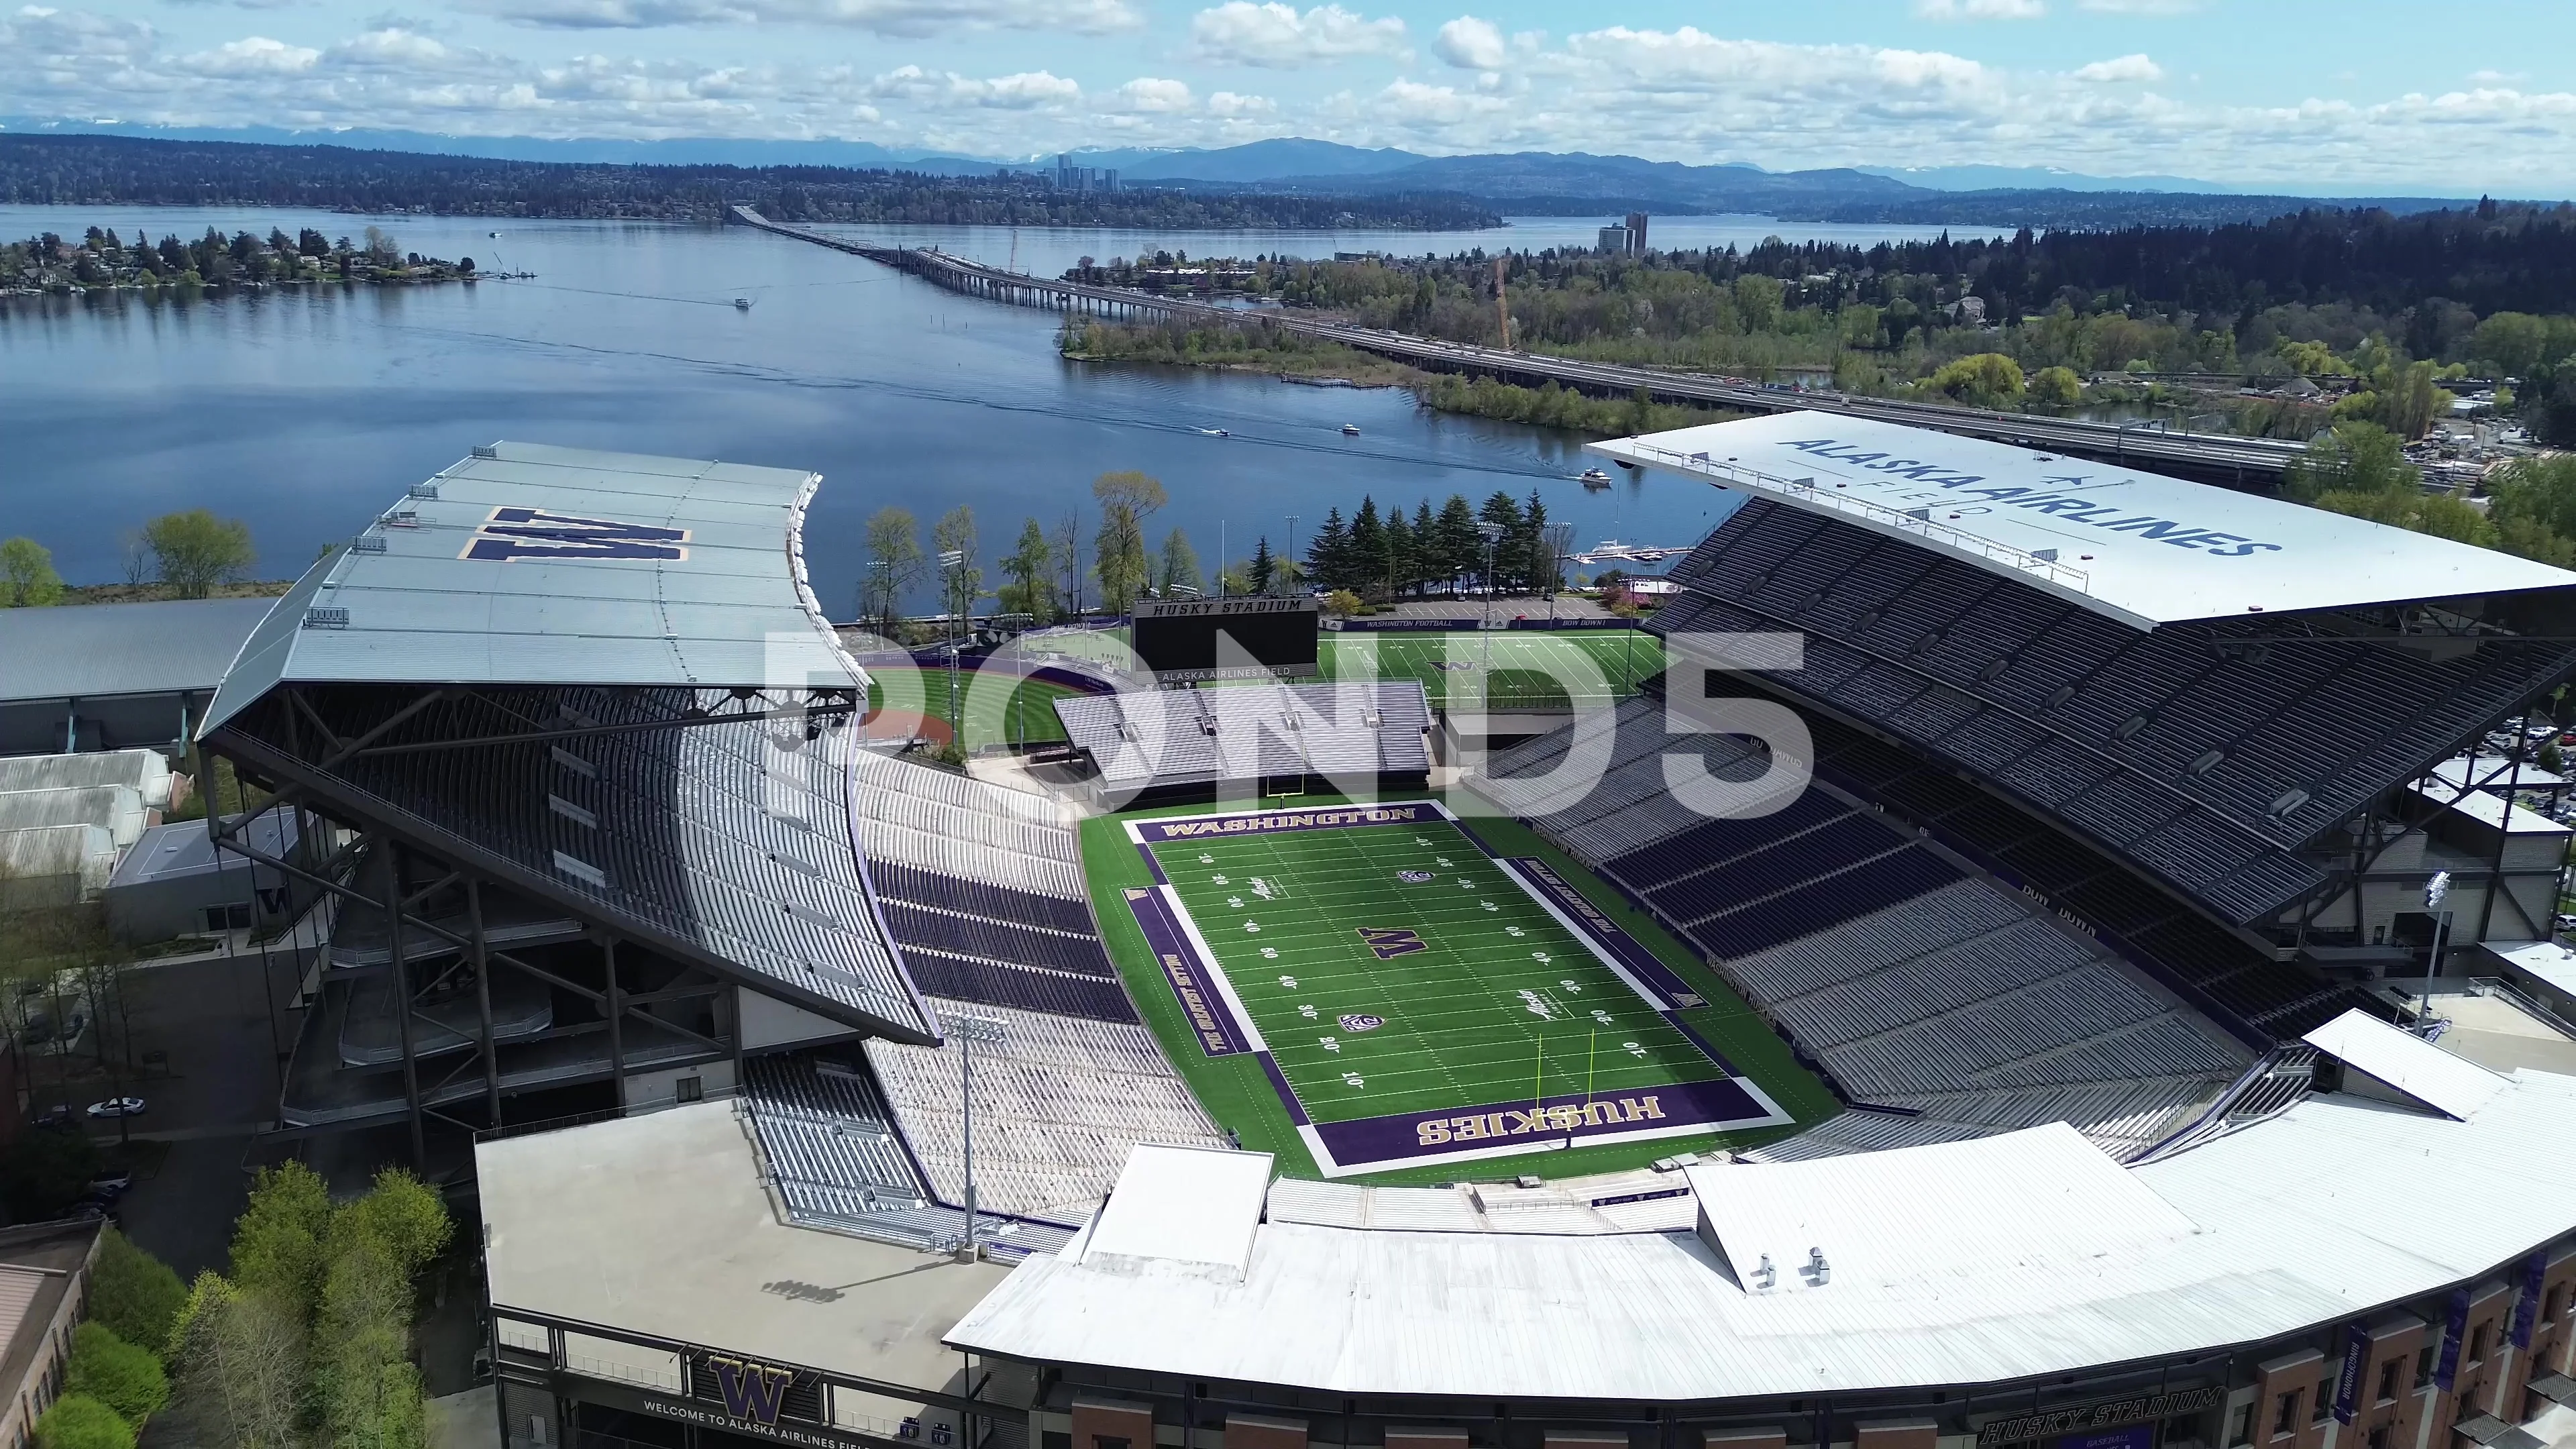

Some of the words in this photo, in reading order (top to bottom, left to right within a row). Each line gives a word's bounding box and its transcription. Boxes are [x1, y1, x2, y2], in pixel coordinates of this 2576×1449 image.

[1775, 439, 1986, 489] ALASKA
[1958, 487, 2283, 556] AIRLINES
[1857, 481, 1992, 515] FIELD
[456, 506, 692, 562] W
[1152, 603, 1214, 616] HUSKY
[1222, 600, 1302, 613] STADIUM
[1425, 661, 1479, 672] W
[1162, 672, 1205, 682] ALASKA
[1210, 669, 1257, 680] AIRLINES
[1261, 667, 1290, 676] FIELD
[1161, 808, 1416, 837] WASHINGTON
[1416, 839, 1433, 847] 10
[1532, 821, 1569, 854] WASHINGTON
[1570, 849, 1596, 872] HUSKIES
[1198, 855, 1214, 863] 10
[1436, 858, 1454, 867] 20
[1212, 875, 1229, 885] 20
[1458, 879, 1475, 889] 30
[1124, 889, 1148, 901] W
[1228, 898, 1244, 908] 30
[1481, 902, 1499, 912] 40
[1244, 922, 1261, 932] 40
[1505, 926, 1525, 936] 50
[1355, 927, 1429, 960] W
[1260, 947, 1279, 959] 50
[1532, 952, 1552, 963] 40
[1279, 975, 1298, 987] 40
[1560, 979, 1582, 991] 30
[1706, 954, 1748, 1001] WASHINGTON
[1748, 993, 1777, 1028] HUSKIES
[1671, 992, 1704, 1007] W
[1297, 1004, 1318, 1017] 30
[1591, 1010, 1614, 1022] 20
[1318, 1036, 1340, 1050] 20
[1622, 1042, 1647, 1055] 10
[1341, 1071, 1364, 1085] 10
[1416, 1095, 1666, 1146] HUSKIES
[708, 1355, 792, 1426] W
[1980, 1409, 2086, 1444] HUSKY
[2091, 1386, 2223, 1427] STADIUM
[643, 1400, 705, 1421] WELCOME
[708, 1414, 725, 1426] TO
[729, 1418, 777, 1438] ALASKA
[780, 1430, 835, 1449] AIRLINES
[2086, 1435, 2129, 1447] BASEBALL
